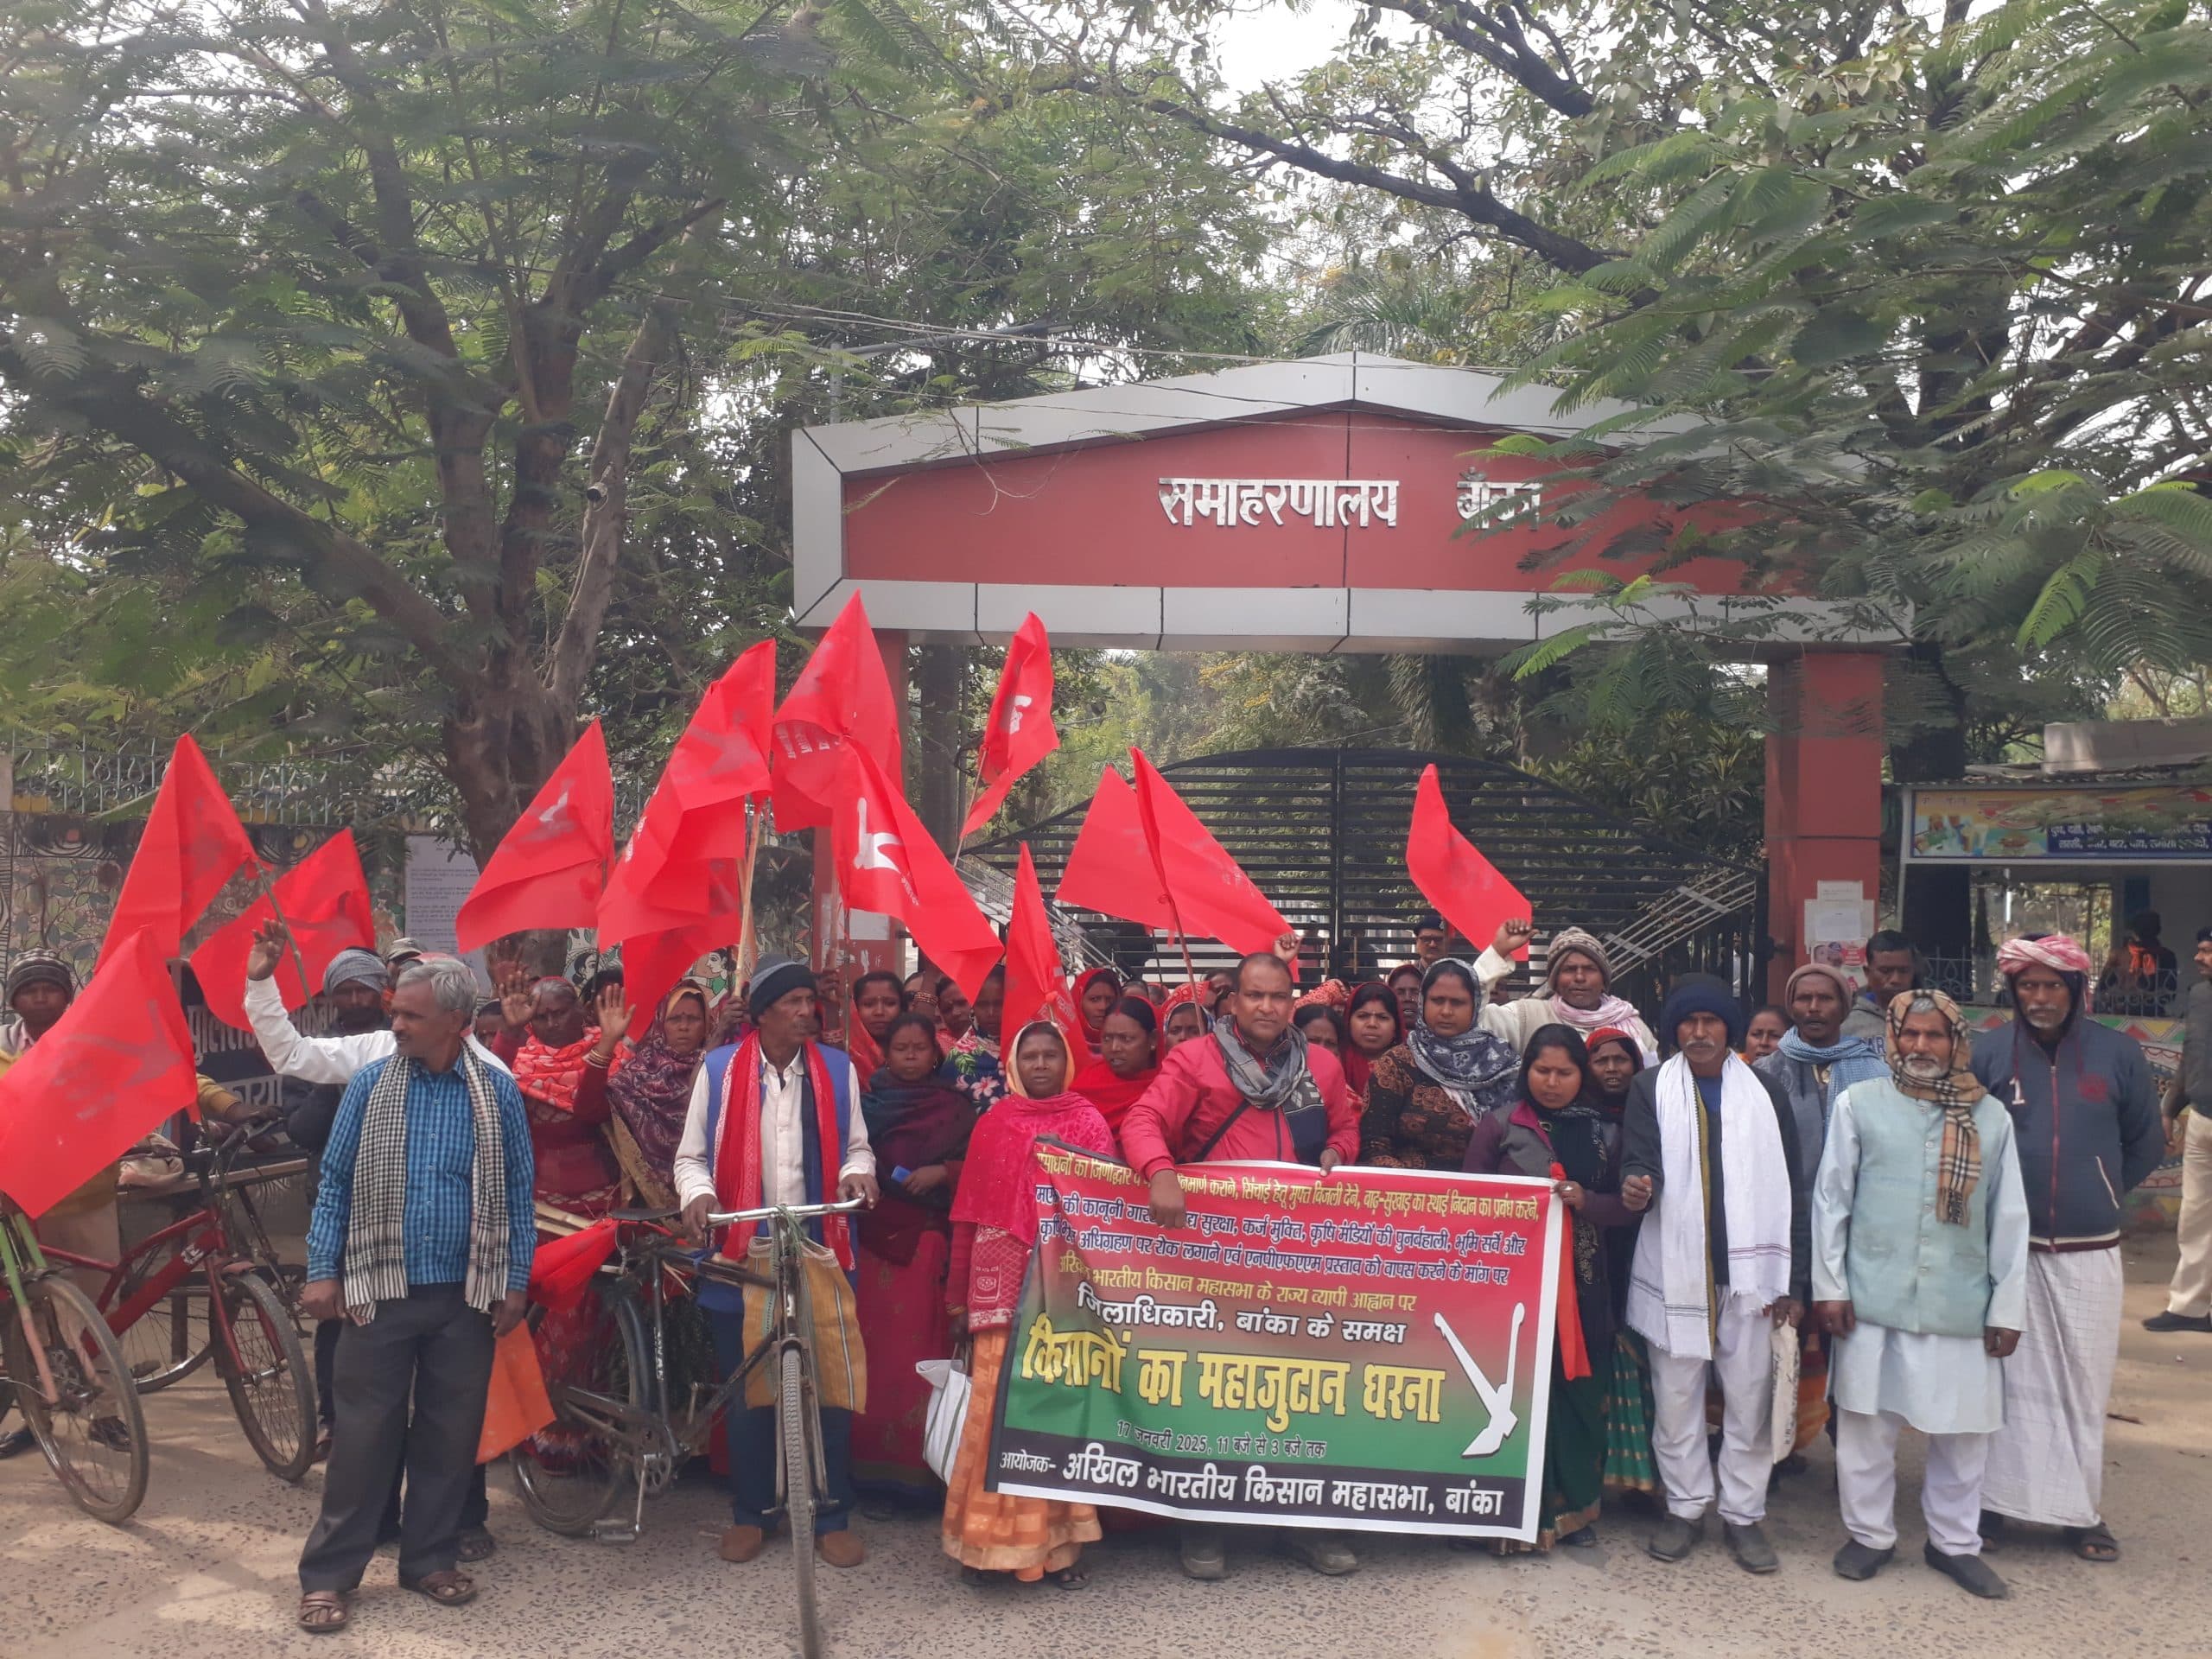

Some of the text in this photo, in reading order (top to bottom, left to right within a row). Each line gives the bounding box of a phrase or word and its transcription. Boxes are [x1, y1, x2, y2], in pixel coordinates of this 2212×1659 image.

[1158, 477, 1400, 528] समाहरणालय
[2008, 1077, 2026, 1106] 1
[1075, 1160, 1089, 1179] का
[1209, 1176, 1238, 1200] कराने,
[1242, 1176, 1271, 1205] सिंचाई
[1343, 1183, 1361, 1210] देने,
[1412, 1192, 1426, 1212] का
[1451, 1189, 1478, 1217] निदान
[1478, 1197, 1492, 1217] का
[1515, 1195, 1540, 1222] करने,
[1063, 1191, 1080, 1216] की
[1082, 1196, 1127, 1224] कानूनी
[1201, 1212, 1238, 1236] सुरक्षा,
[1243, 1214, 1270, 1236] कर्ज
[1269, 1216, 1306, 1243] मुक्ति,
[1310, 1218, 1338, 1248] कृषि
[1338, 1219, 1376, 1245] मंडियों
[1376, 1223, 1394, 1246] की
[1454, 1228, 1480, 1256] भूमि
[1503, 1231, 1529, 1256] और
[1079, 1225, 1133, 1253] अधिग्रहण
[1135, 1236, 1154, 1255] पर
[1154, 1233, 1181, 1256] रोक
[1181, 1241, 1223, 1263] लगाने
[1224, 1242, 1243, 1267] एवं
[1323, 1255, 1364, 1276] प्रस्ताव
[1364, 1254, 1383, 1276] को
[1417, 1256, 1449, 1281] करने
[1448, 1259, 1464, 1282] के
[1464, 1259, 1492, 1284] मांग
[1491, 1266, 1511, 1286] पर
[1077, 1281, 1408, 1344] जिलाधिकारी, बांका के समक्ष
[1092, 1264, 1143, 1290] भारतीय
[1146, 1266, 1193, 1293] किसान
[1196, 1274, 1255, 1300] महासभा
[1256, 1280, 1274, 1301] के
[1276, 1285, 1309, 1306] राज्य
[1312, 1285, 1349, 1308] व्यापी
[1398, 1294, 1418, 1313] पर
[1137, 1349, 1189, 1408] का
[1197, 1351, 1352, 1433] महाजुटान
[1362, 1363, 1447, 1424] धरना
[1133, 1427, 1173, 1451] जनवरी
[1175, 1434, 1212, 1456] 2025,
[1216, 1436, 1230, 1454] 11
[1233, 1433, 1252, 1455] बजे
[1255, 1433, 1268, 1456] से
[1270, 1437, 1280, 1456] 3
[1283, 1433, 1302, 1457] बजे
[1306, 1440, 1328, 1459] तक
[1000, 1442, 1504, 1516] आयोजक- अखिल भारतीय किसान महासभा, बांका
